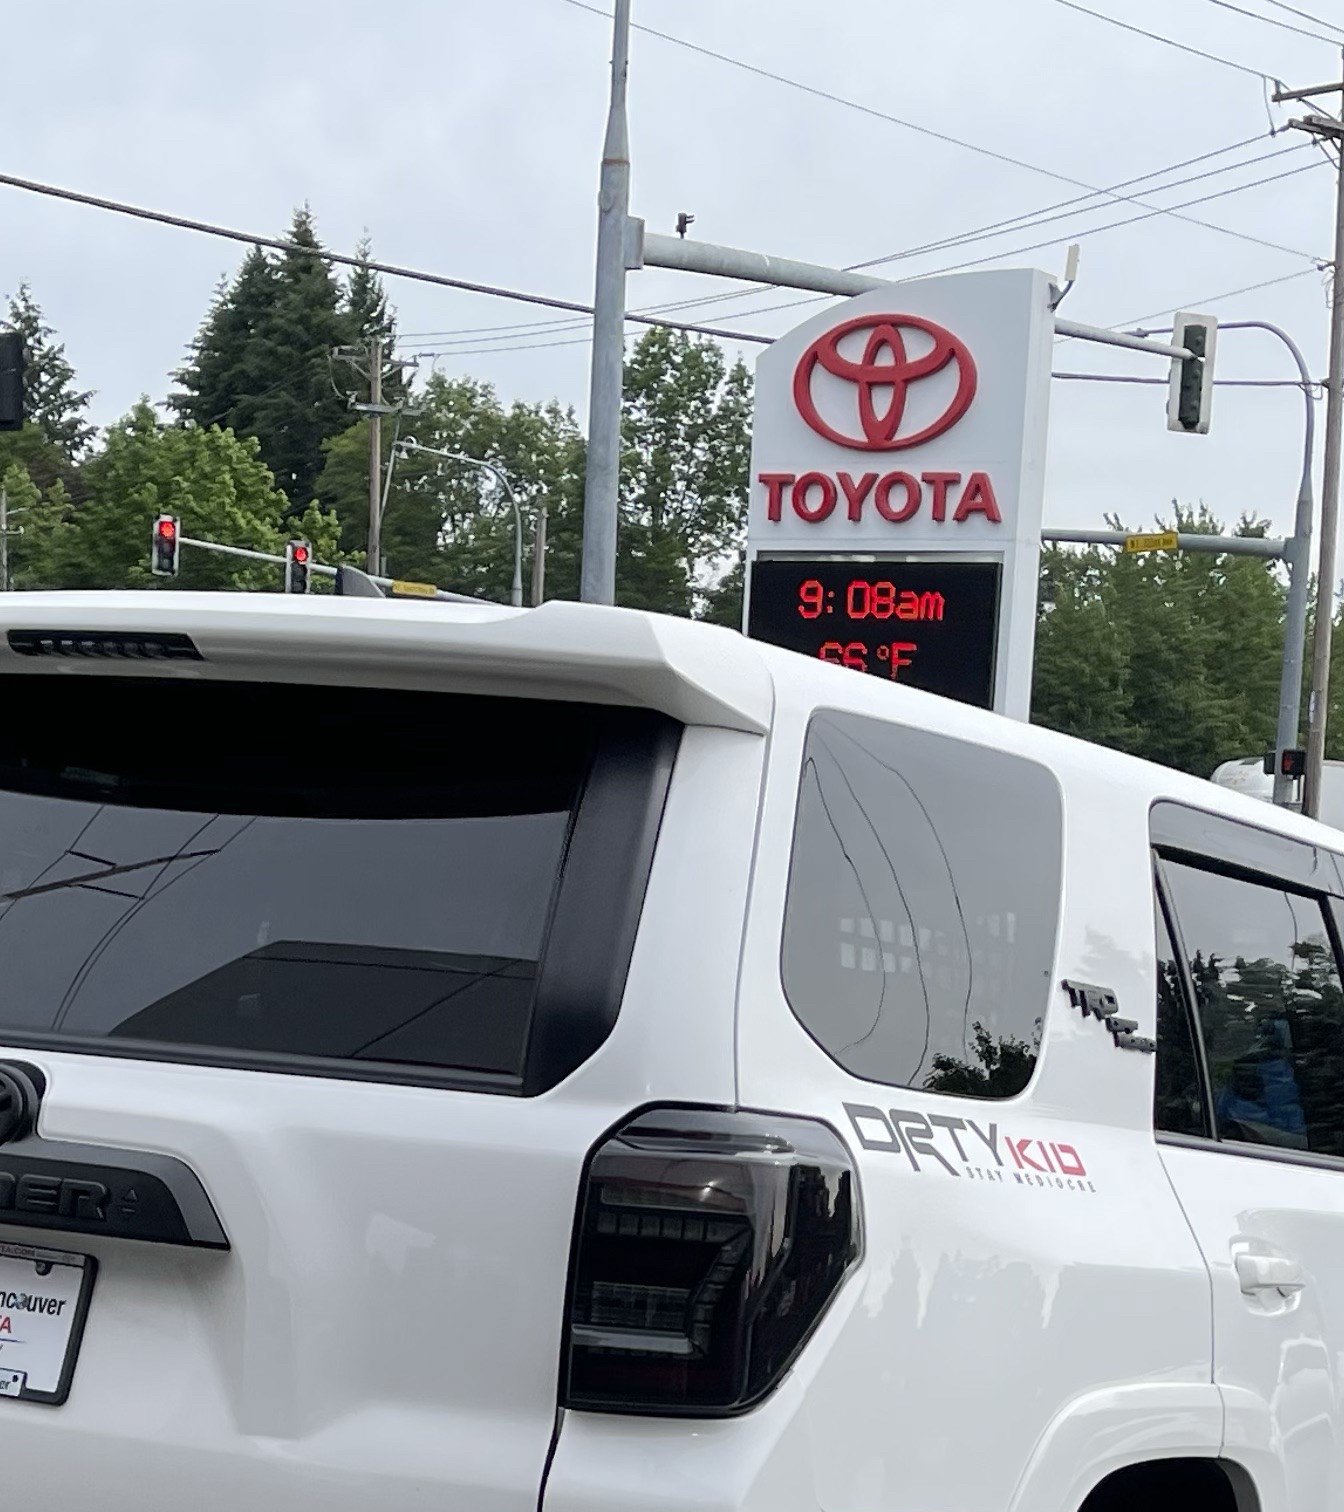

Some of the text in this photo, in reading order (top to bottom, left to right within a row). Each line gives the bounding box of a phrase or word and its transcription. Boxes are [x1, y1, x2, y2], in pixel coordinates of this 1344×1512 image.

[758, 470, 1002, 524] TOYOTA
[798, 579, 945, 622] 9:08am
[965, 1166, 1003, 1183] STAY
